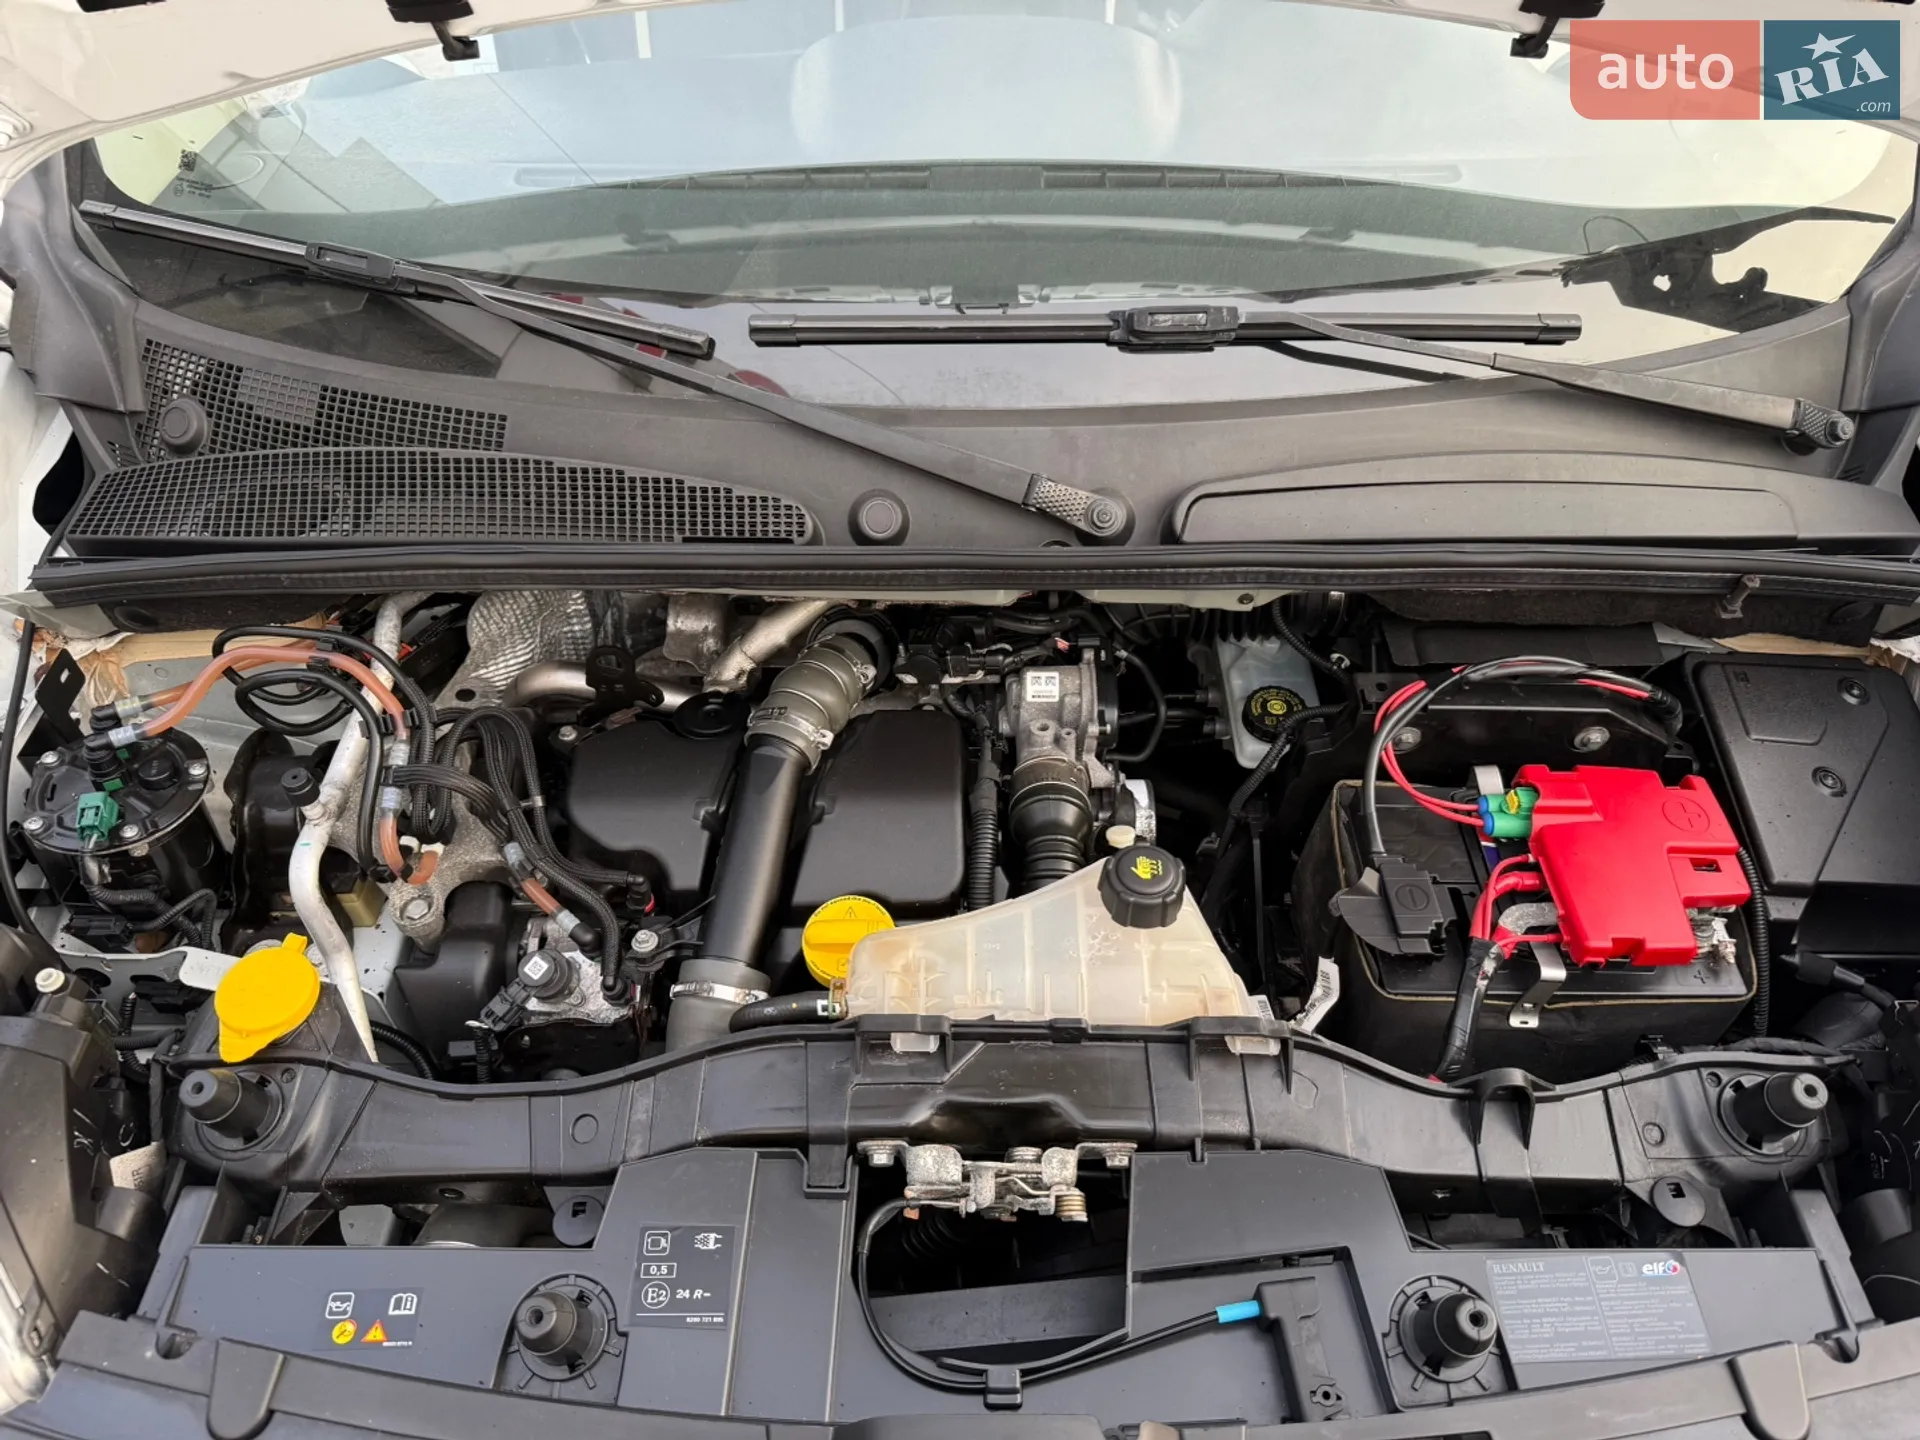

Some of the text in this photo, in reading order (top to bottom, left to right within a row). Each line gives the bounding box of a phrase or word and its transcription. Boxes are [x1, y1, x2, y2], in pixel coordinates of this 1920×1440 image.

[649, 1265, 668, 1276] 0,5
[1492, 1262, 1545, 1273] RENAULT
[1642, 1261, 1665, 1275] elf
[646, 1287, 667, 1303] E2
[676, 1289, 691, 1299] 24
